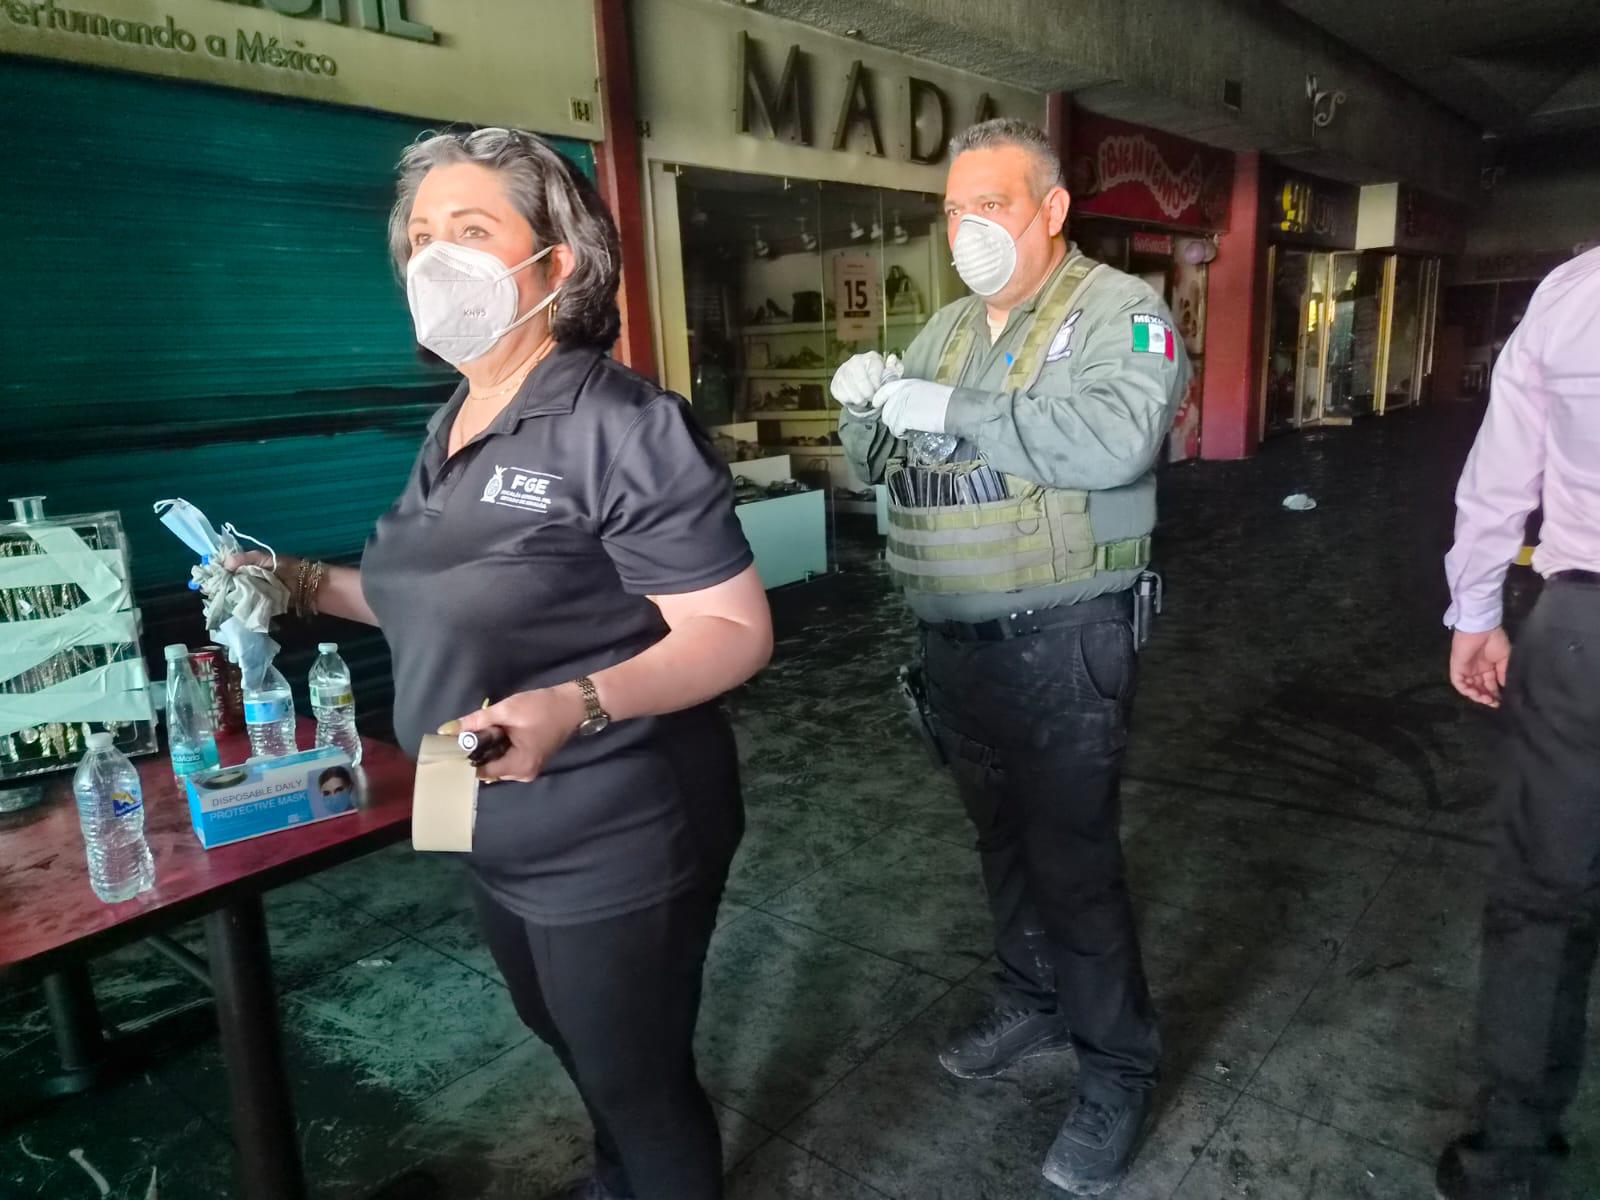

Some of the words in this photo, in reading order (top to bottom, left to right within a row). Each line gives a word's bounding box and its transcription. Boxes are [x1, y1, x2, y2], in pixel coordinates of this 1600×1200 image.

[0, 0, 197, 52] erfumando
[204, 34, 226, 58] a
[235, 28, 337, 76] México
[844, 279, 868, 310] 15
[510, 473, 551, 495] FGE
[209, 798, 277, 822] PROTECTIVE
[277, 791, 307, 805] MASK
[211, 785, 273, 807] DISPOSABLE
[275, 778, 304, 793] DAILY
